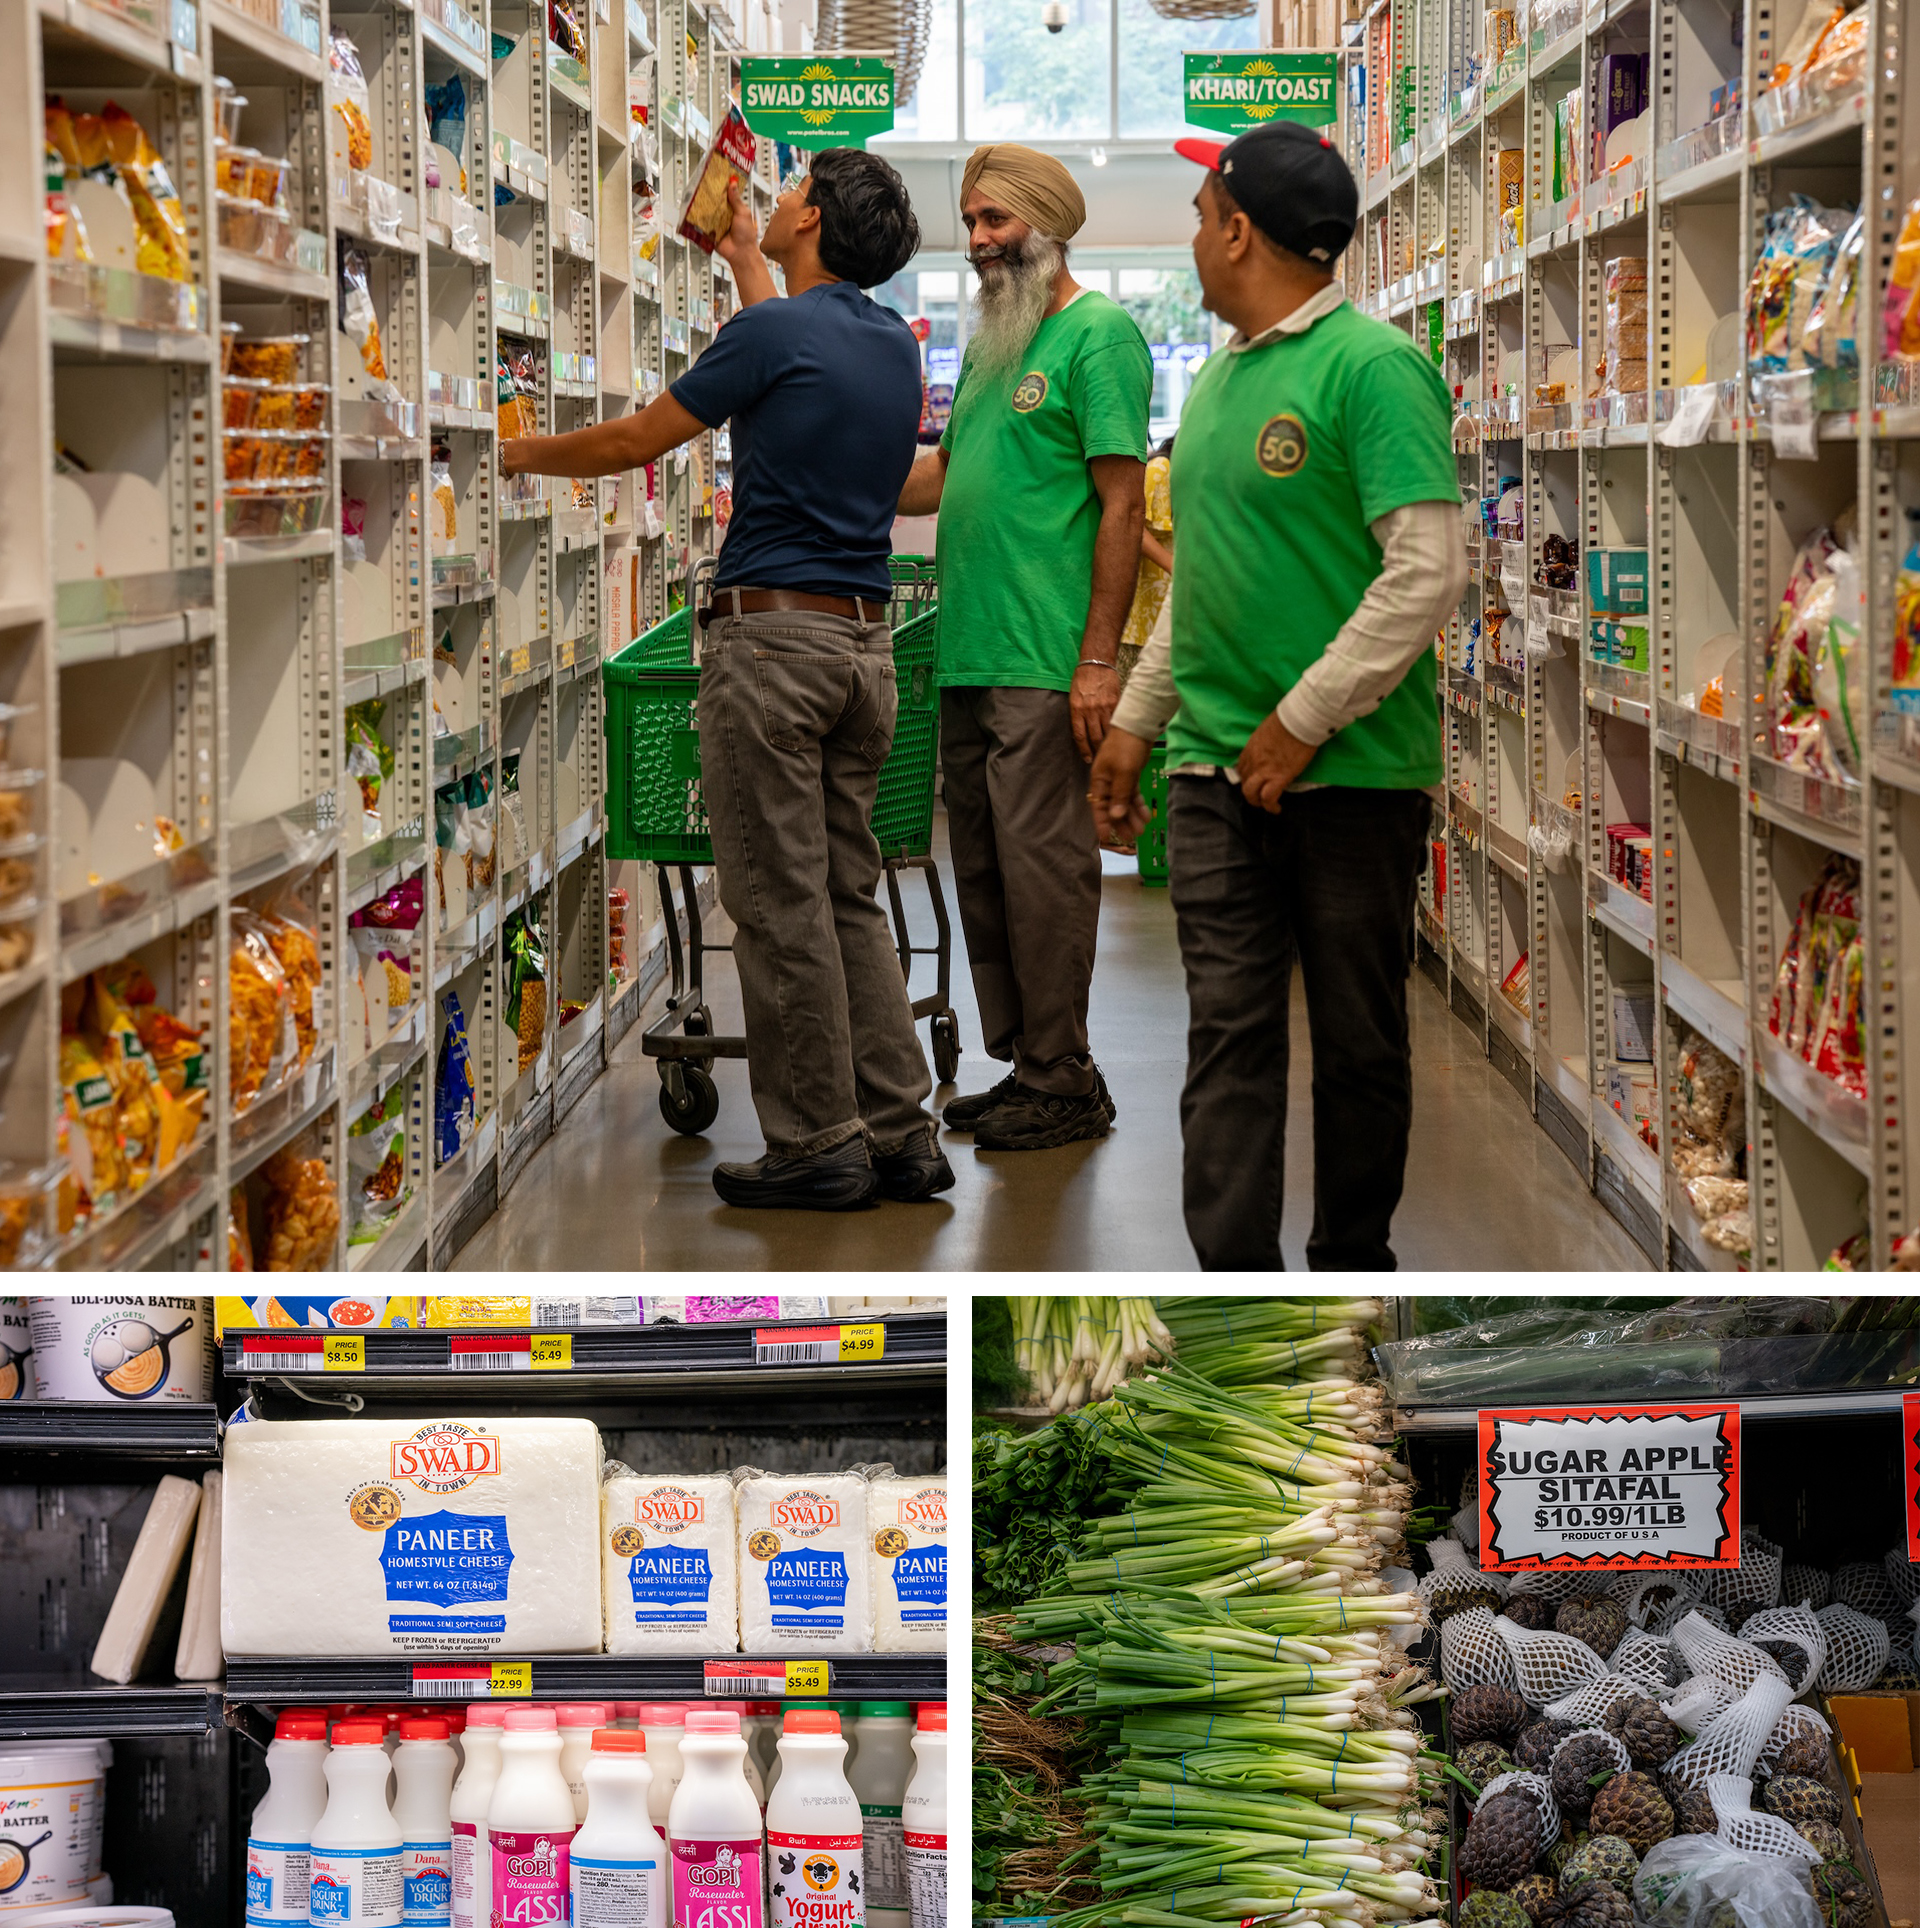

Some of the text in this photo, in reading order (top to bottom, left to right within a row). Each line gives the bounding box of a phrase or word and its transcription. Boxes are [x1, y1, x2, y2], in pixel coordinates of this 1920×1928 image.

[747, 84, 890, 106] SWAD SNACKS
[1189, 78, 1332, 102] KHARI/TOAST
[787, 129, 849, 137] www.patelbros.com
[1014, 386, 1040, 403] 50
[1262, 436, 1300, 464] 50
[612, 587, 620, 618] MASALA
[71, 1296, 197, 1311] IDLI-DOSA BATTER
[85, 1322, 101, 1345] GOOD
[101, 1315, 112, 1324] AS
[122, 1311, 146, 1320] GETS!
[851, 1328, 874, 1336] PRICE
[841, 1339, 874, 1351] $4.99
[327, 1352, 358, 1363] $8.50
[532, 1350, 562, 1362] $6.49
[416, 1423, 470, 1441] BEST TASTE
[400, 1442, 490, 1474] SWAD
[1485, 1445, 1733, 1475] SUGAR APPLE
[418, 1477, 467, 1492] IN TOWN
[1538, 1476, 1681, 1503] SITAFAL
[652, 1487, 687, 1498] BEST TASTE
[786, 1492, 820, 1502] BEST TASTE
[917, 1489, 947, 1499] BEST TAS
[641, 1500, 698, 1520] SWAD
[777, 1504, 834, 1524] SWAD
[905, 1502, 947, 1520] SWA
[1534, 1506, 1686, 1529] $10.99/1LB
[665, 1524, 685, 1533] TOWN
[801, 1528, 821, 1537] TOWN
[931, 1525, 947, 1533] TOW
[397, 1528, 495, 1551] PANEER
[1561, 1531, 1611, 1541] PRODUCT
[1614, 1532, 1628, 1540] OF
[388, 1556, 505, 1568] HOMESTYLE CHEESE
[635, 1558, 706, 1574] PANEER
[899, 1558, 947, 1574] PANE
[772, 1561, 843, 1578] PANEER
[396, 1581, 497, 1591] NET WT. 64 OZ (1,814g)
[770, 1580, 845, 1588] HOMESTYLE CHEESE
[897, 1576, 943, 1584] HOMESTYLE
[486, 1679, 522, 1690] $22.99
[788, 1677, 819, 1688] $5.49
[3, 1815, 49, 1828] BATTER
[498, 1836, 516, 1848] लस्सी
[829, 1837, 857, 1848] شراب لبن
[908, 1835, 936, 1846] شراب لبن
[678, 1844, 697, 1856] लस्सी
[313, 1858, 330, 1872] Dana
[414, 1853, 440, 1866] Dana
[809, 1855, 833, 1864] karoun
[507, 1856, 553, 1877] GOPI
[687, 1864, 737, 1886] GOPI
[409, 1883, 452, 1893] YOGURT
[507, 1877, 560, 1889] Rosewater
[414, 1893, 448, 1902] DRINK
[689, 1887, 745, 1899] Rosewater
[806, 1892, 837, 1901] Original
[312, 1899, 337, 1911] DRINK
[503, 1895, 565, 1923] LASSI
[785, 1896, 855, 1922] Yogurt
